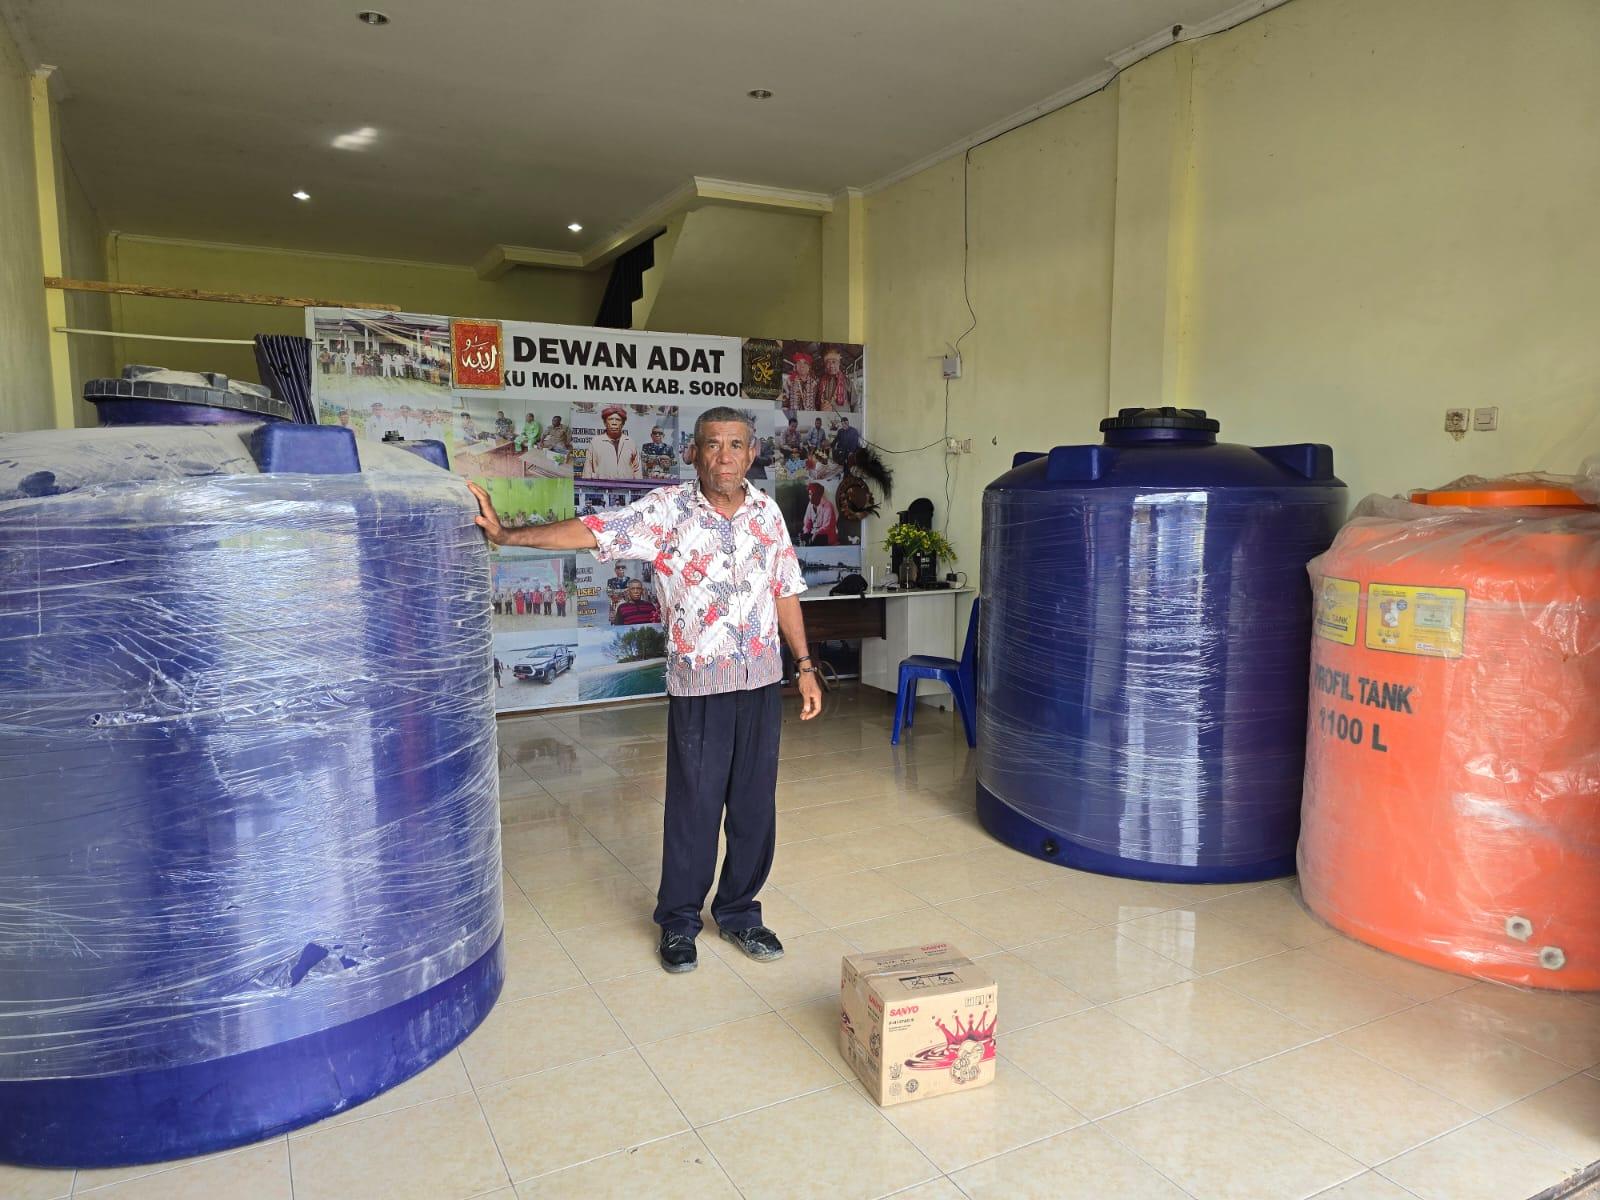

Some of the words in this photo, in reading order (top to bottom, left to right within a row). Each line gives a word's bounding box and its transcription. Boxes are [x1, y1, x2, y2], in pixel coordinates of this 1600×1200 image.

[513, 336, 637, 369] DEWAN
[647, 346, 725, 374] ADAT
[532, 372, 578, 390] MOI.
[583, 374, 637, 393] MAYA
[642, 377, 684, 395] KAB.
[1358, 676, 1413, 714] TANK
[1372, 723, 1387, 753] L
[889, 1005, 919, 1017] SANYO
